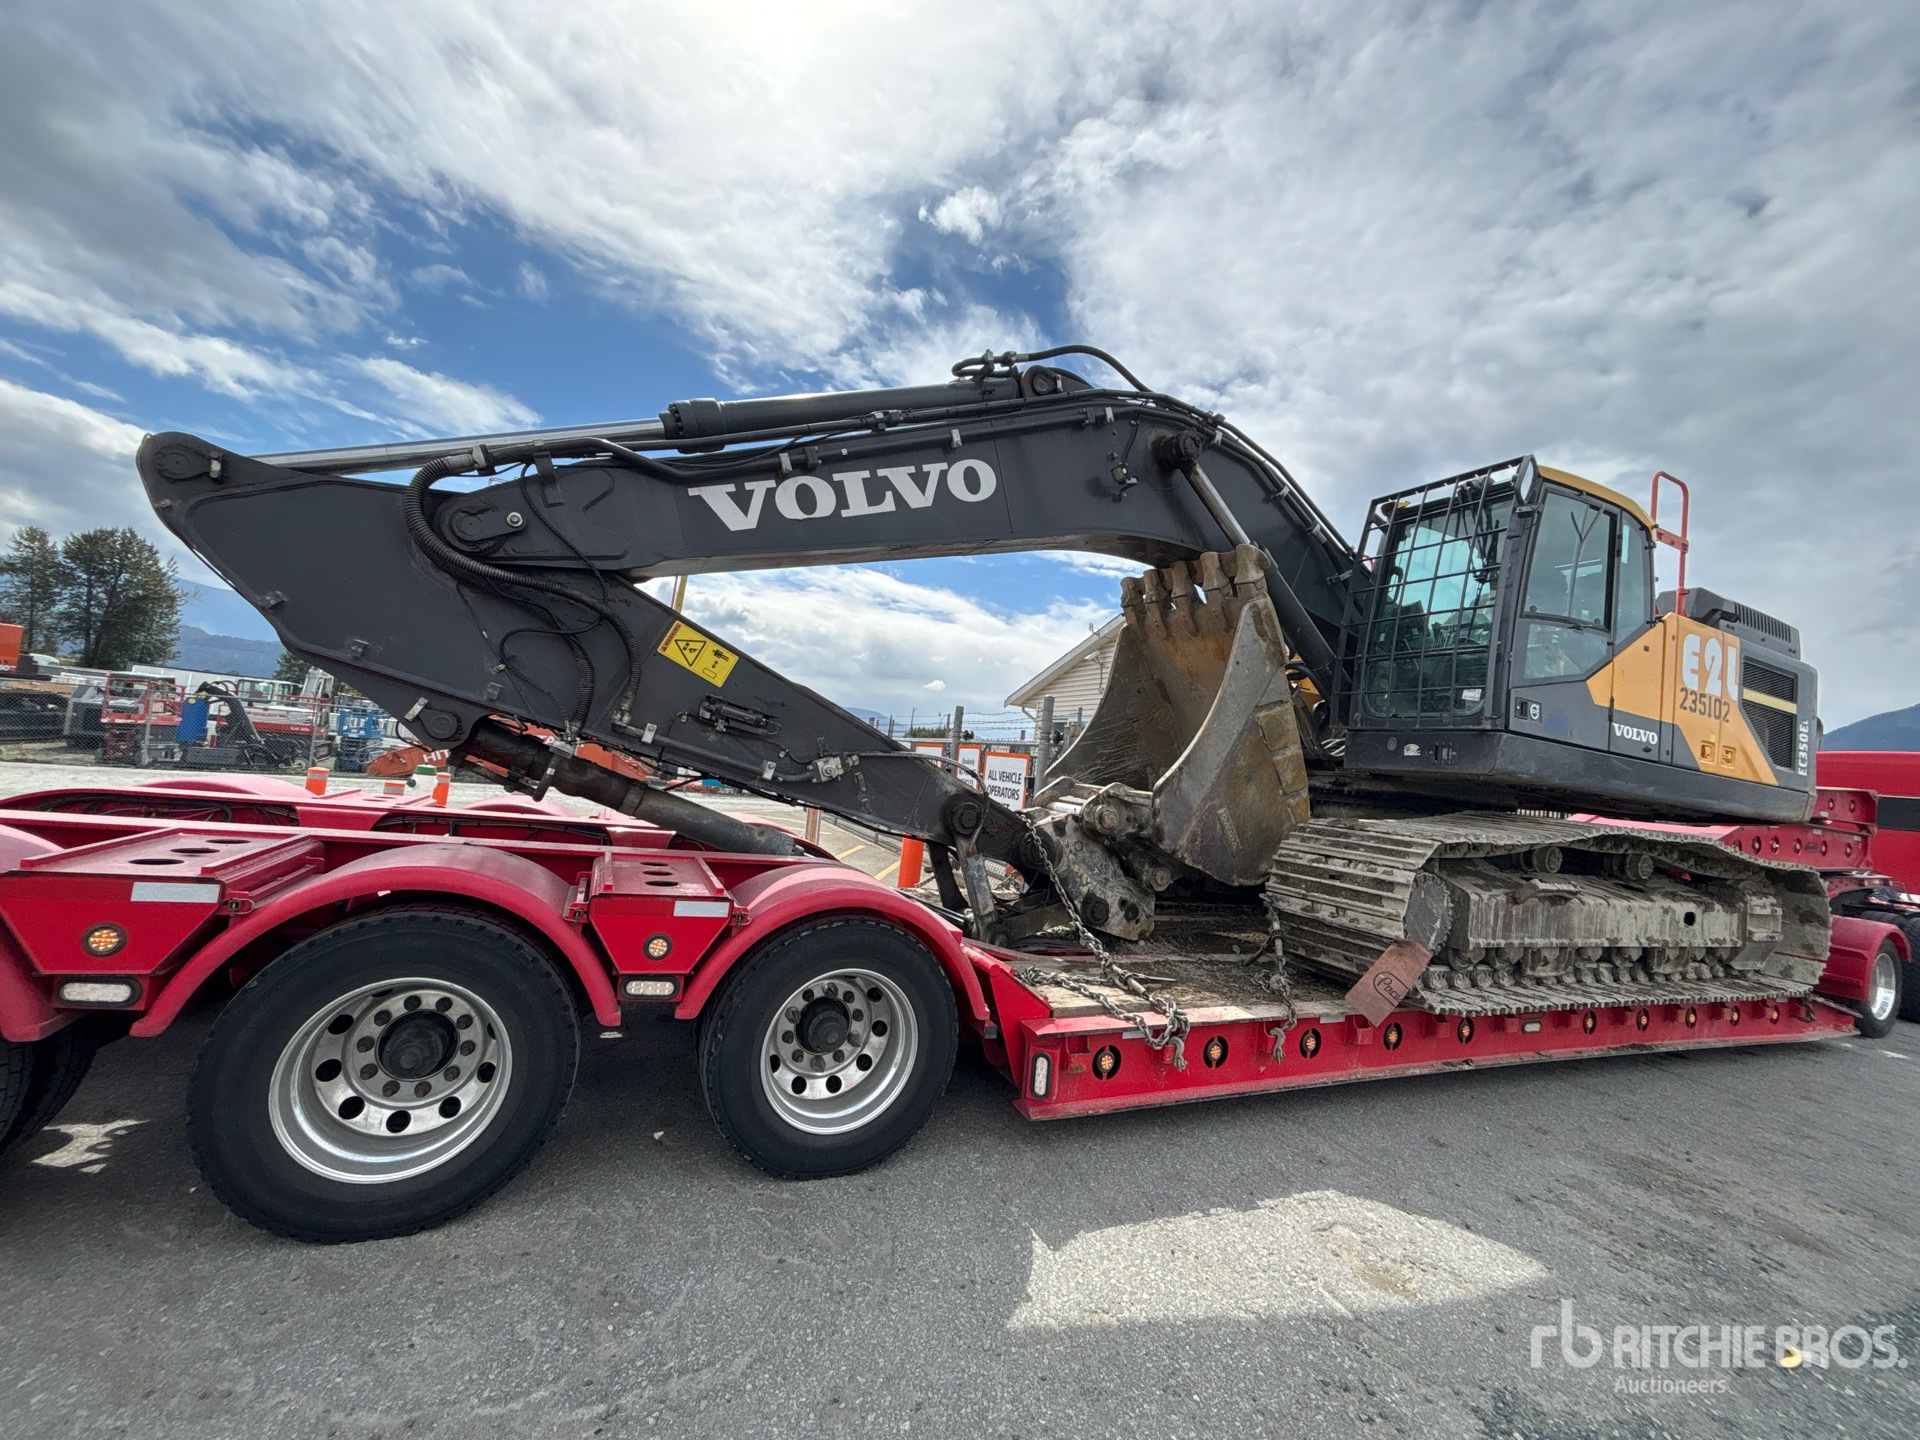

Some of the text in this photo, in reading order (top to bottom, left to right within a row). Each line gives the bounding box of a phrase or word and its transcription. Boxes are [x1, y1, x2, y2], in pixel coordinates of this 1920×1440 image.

[687, 459, 997, 532] VOLVO
[1679, 687, 1731, 723] 235102
[1612, 722, 1658, 745] VOLVO
[987, 769, 998, 781] ALL
[998, 770, 1022, 785] VEHICLE
[987, 784, 1020, 801] OPERATORS
